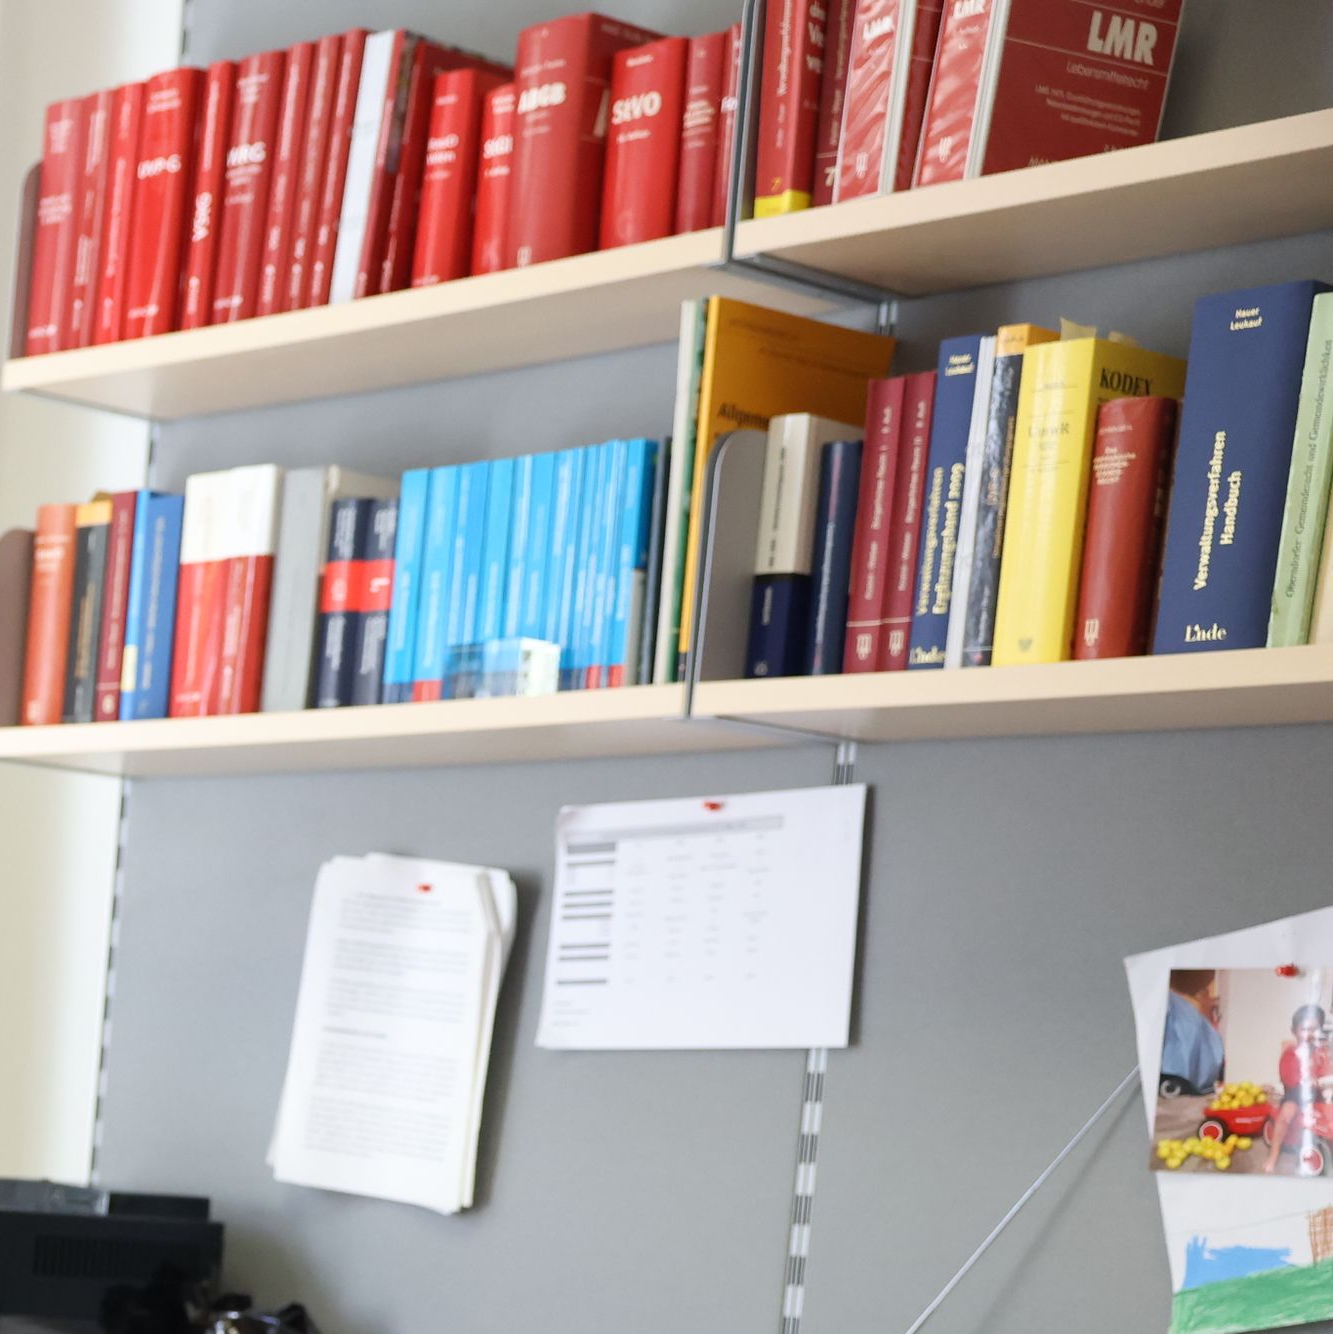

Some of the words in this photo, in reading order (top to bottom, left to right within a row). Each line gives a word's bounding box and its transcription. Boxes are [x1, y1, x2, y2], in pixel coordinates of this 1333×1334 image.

[1087, 10, 1159, 66] LMR
[1066, 61, 1150, 91] Lebensmittelrecht
[612, 91, 662, 125] StVO
[1230, 317, 1263, 331] Leukauf
[1235, 308, 1259, 319] Hauer
[1193, 431, 1226, 591] Verwaltungsverfahren
[1220, 470, 1242, 545] Handbuch
[1185, 623, 1227, 643] Linde
